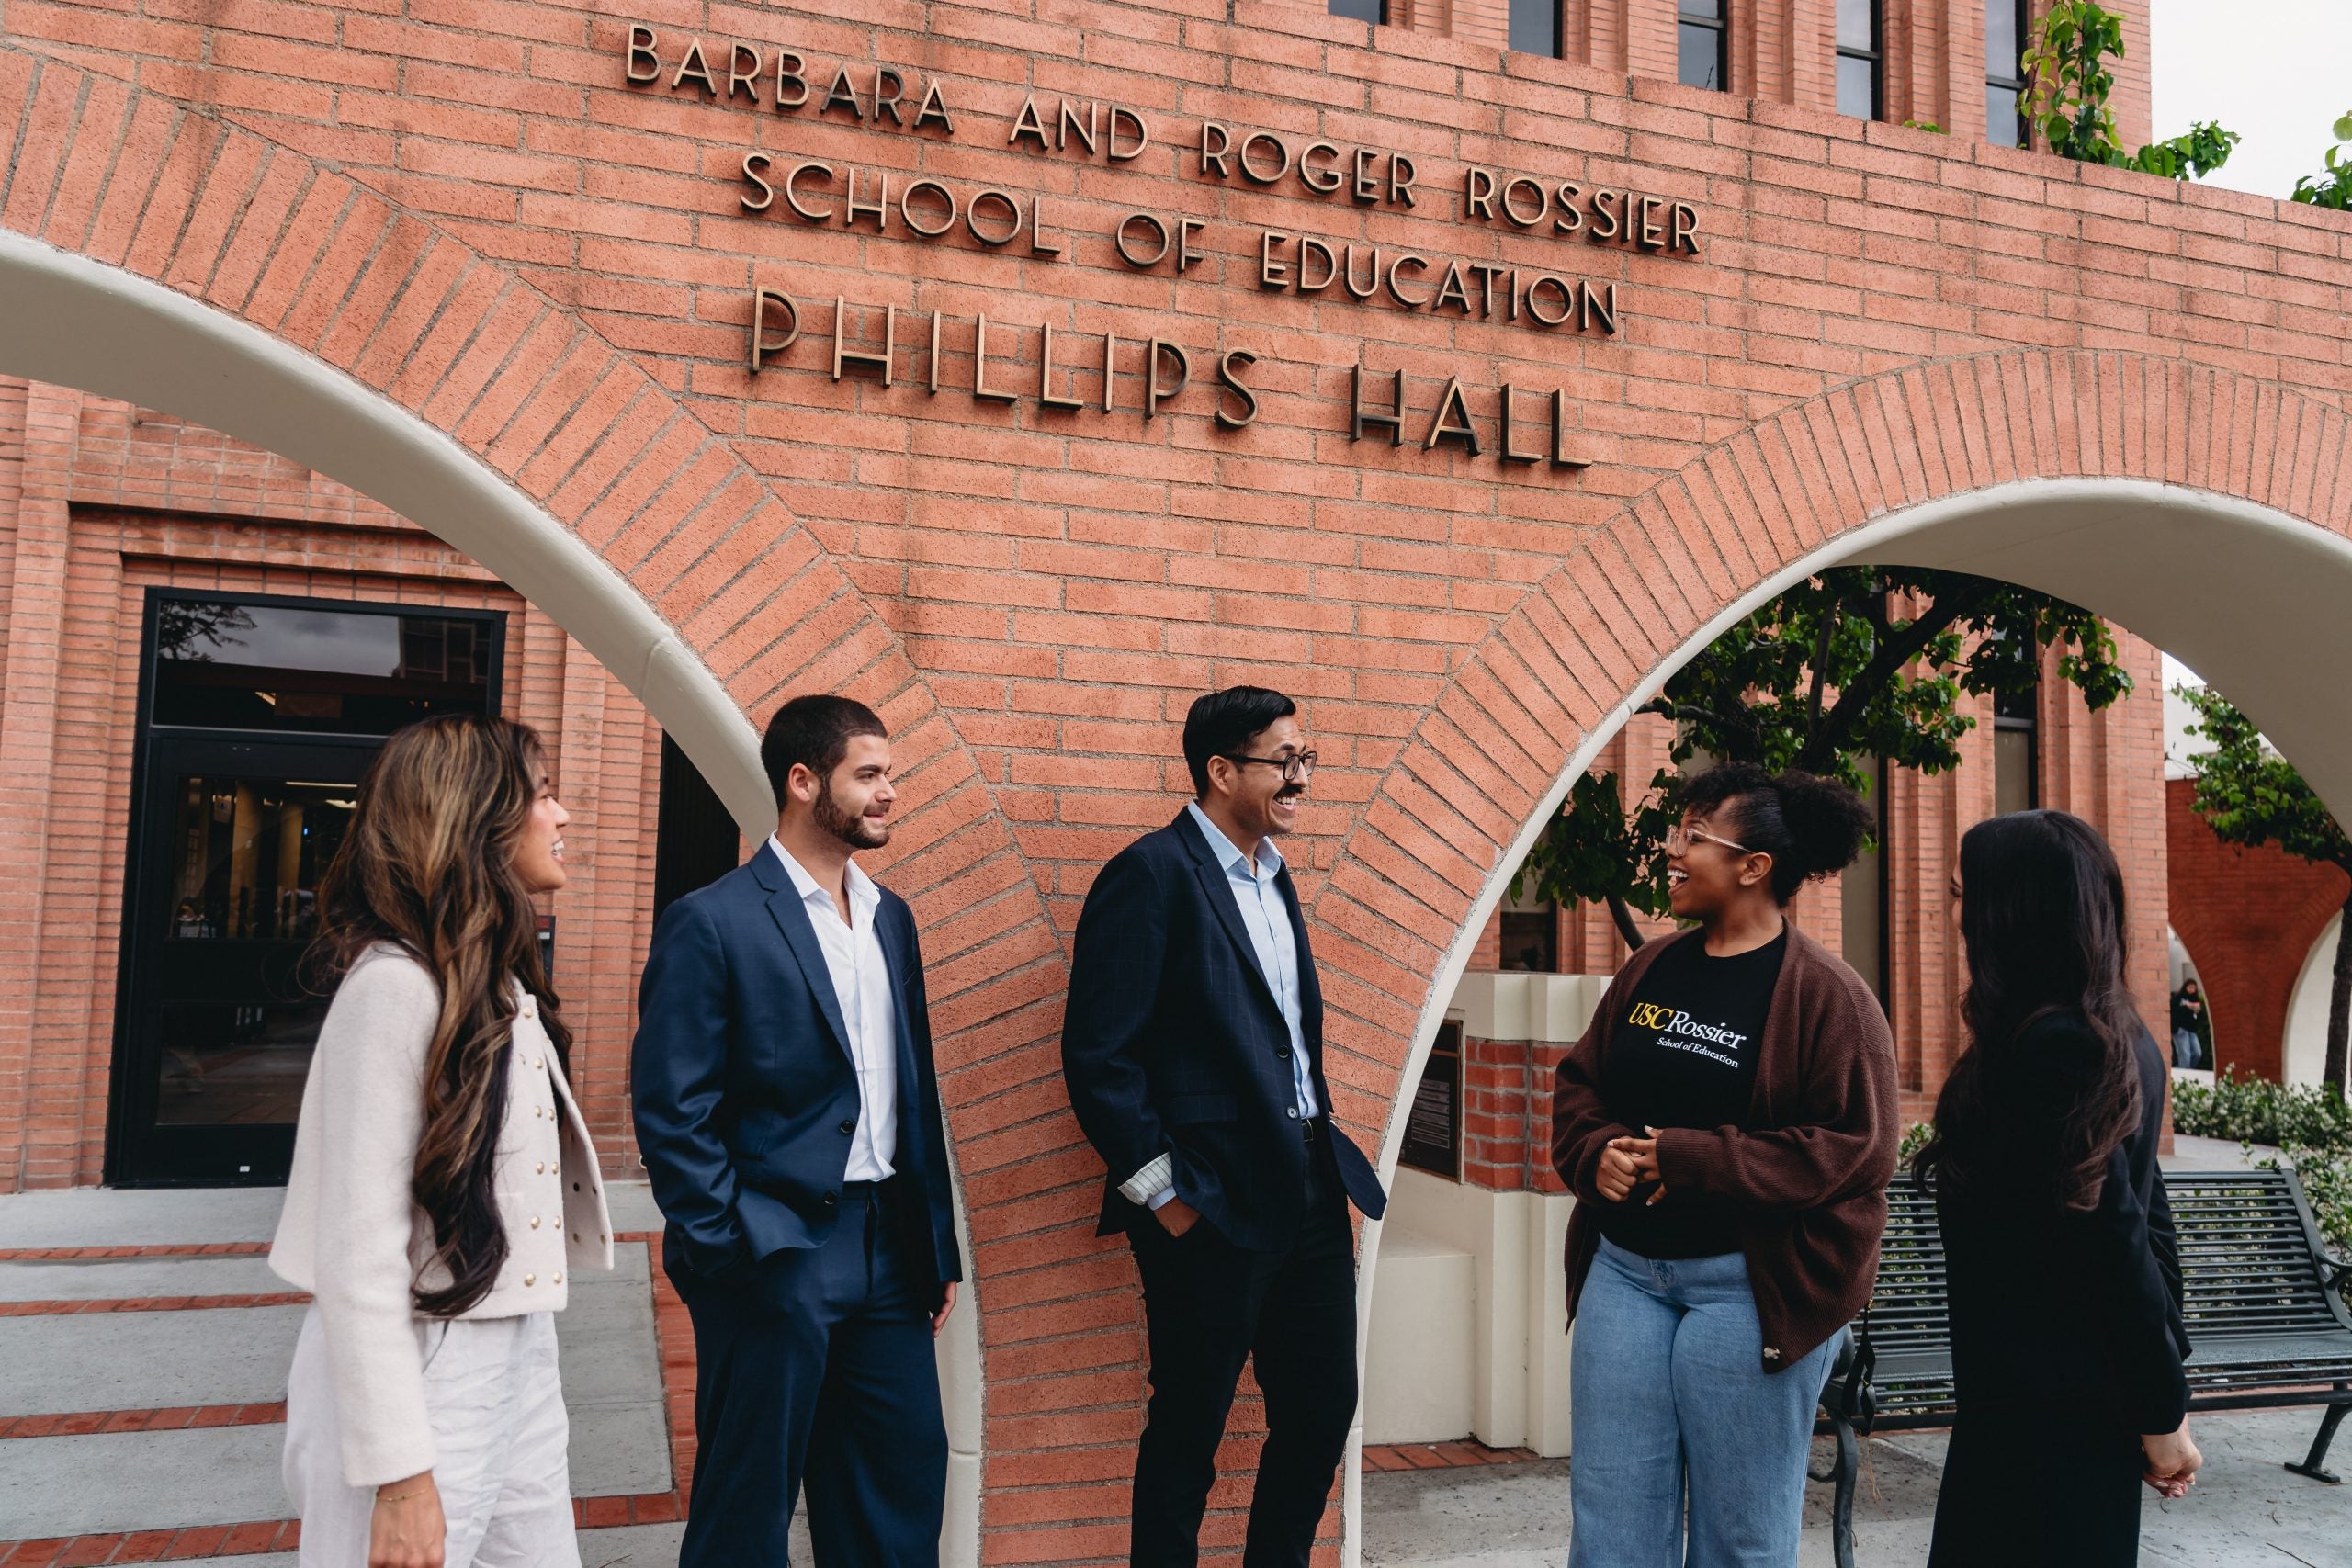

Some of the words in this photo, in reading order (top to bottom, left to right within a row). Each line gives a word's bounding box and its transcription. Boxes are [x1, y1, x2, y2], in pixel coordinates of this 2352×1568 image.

[626, 23, 955, 135] BARBARA
[1007, 94, 1148, 163] AND
[1199, 121, 1417, 209] ROGER
[1465, 166, 1700, 255] ROSSIER
[740, 152, 1060, 256] SCHOOL
[1114, 213, 1206, 273] OF
[1260, 231, 1617, 335] EDUCATION
[751, 286, 1260, 429] PHILLIPS
[1351, 362, 1593, 470] HALL
[1657, 1037, 1683, 1050] School
[1682, 1043, 1694, 1051] of
[1691, 1043, 1738, 1068] Education
